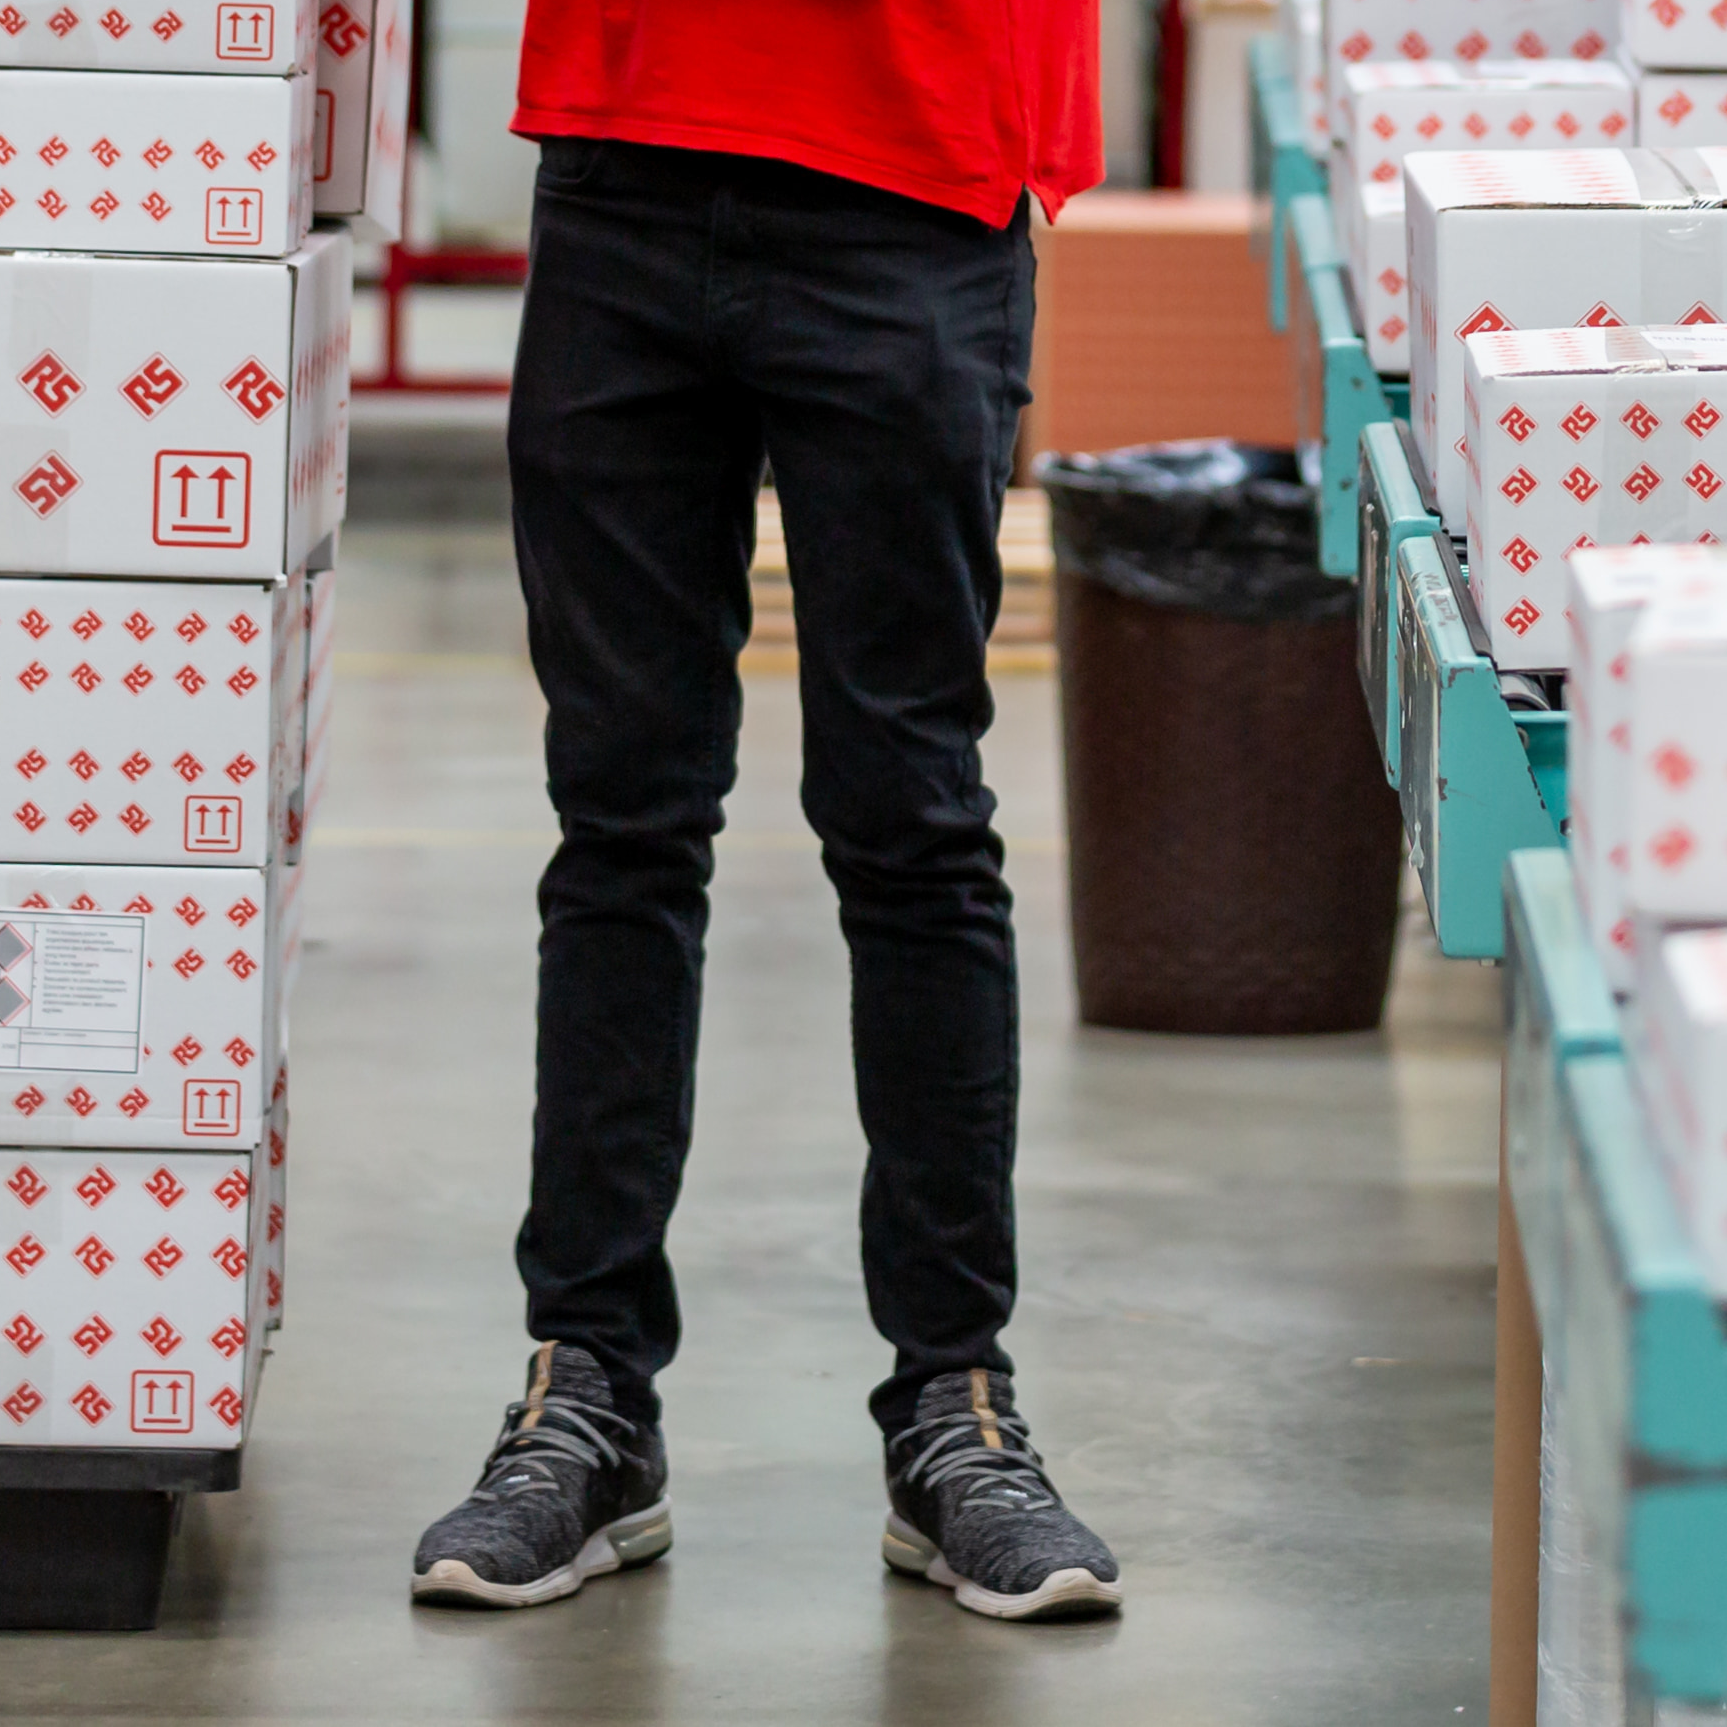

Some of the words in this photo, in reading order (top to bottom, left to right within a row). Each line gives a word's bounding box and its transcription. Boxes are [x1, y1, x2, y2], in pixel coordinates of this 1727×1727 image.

[38, 136, 69, 167] RS
[90, 137, 122, 168] RS
[142, 139, 173, 169] RS
[194, 139, 225, 171] RS
[246, 141, 278, 172] RS
[21, 354, 81, 413] RS
[122, 357, 183, 417] RS
[225, 360, 285, 420] RS
[1499, 405, 1537, 443] RS
[1560, 404, 1598, 442] RS
[1621, 402, 1660, 440] RS
[1683, 400, 1721, 438] RS
[18, 456, 78, 515] RS
[1501, 467, 1538, 505] RS
[1562, 466, 1600, 503] RS
[1623, 464, 1661, 502] RS
[1685, 462, 1723, 500] RS
[1502, 536, 1540, 574] RS
[1504, 598, 1541, 636] RS
[17, 661, 50, 693] RS
[70, 662, 102, 694] RS
[122, 663, 154, 695] RS
[174, 664, 207, 696] RS
[226, 665, 258, 697] RS
[173, 948, 205, 979] RS
[225, 949, 257, 980] RS
[7, 1165, 48, 1207] RS
[75, 1167, 116, 1208] RS
[144, 1168, 185, 1209] RS
